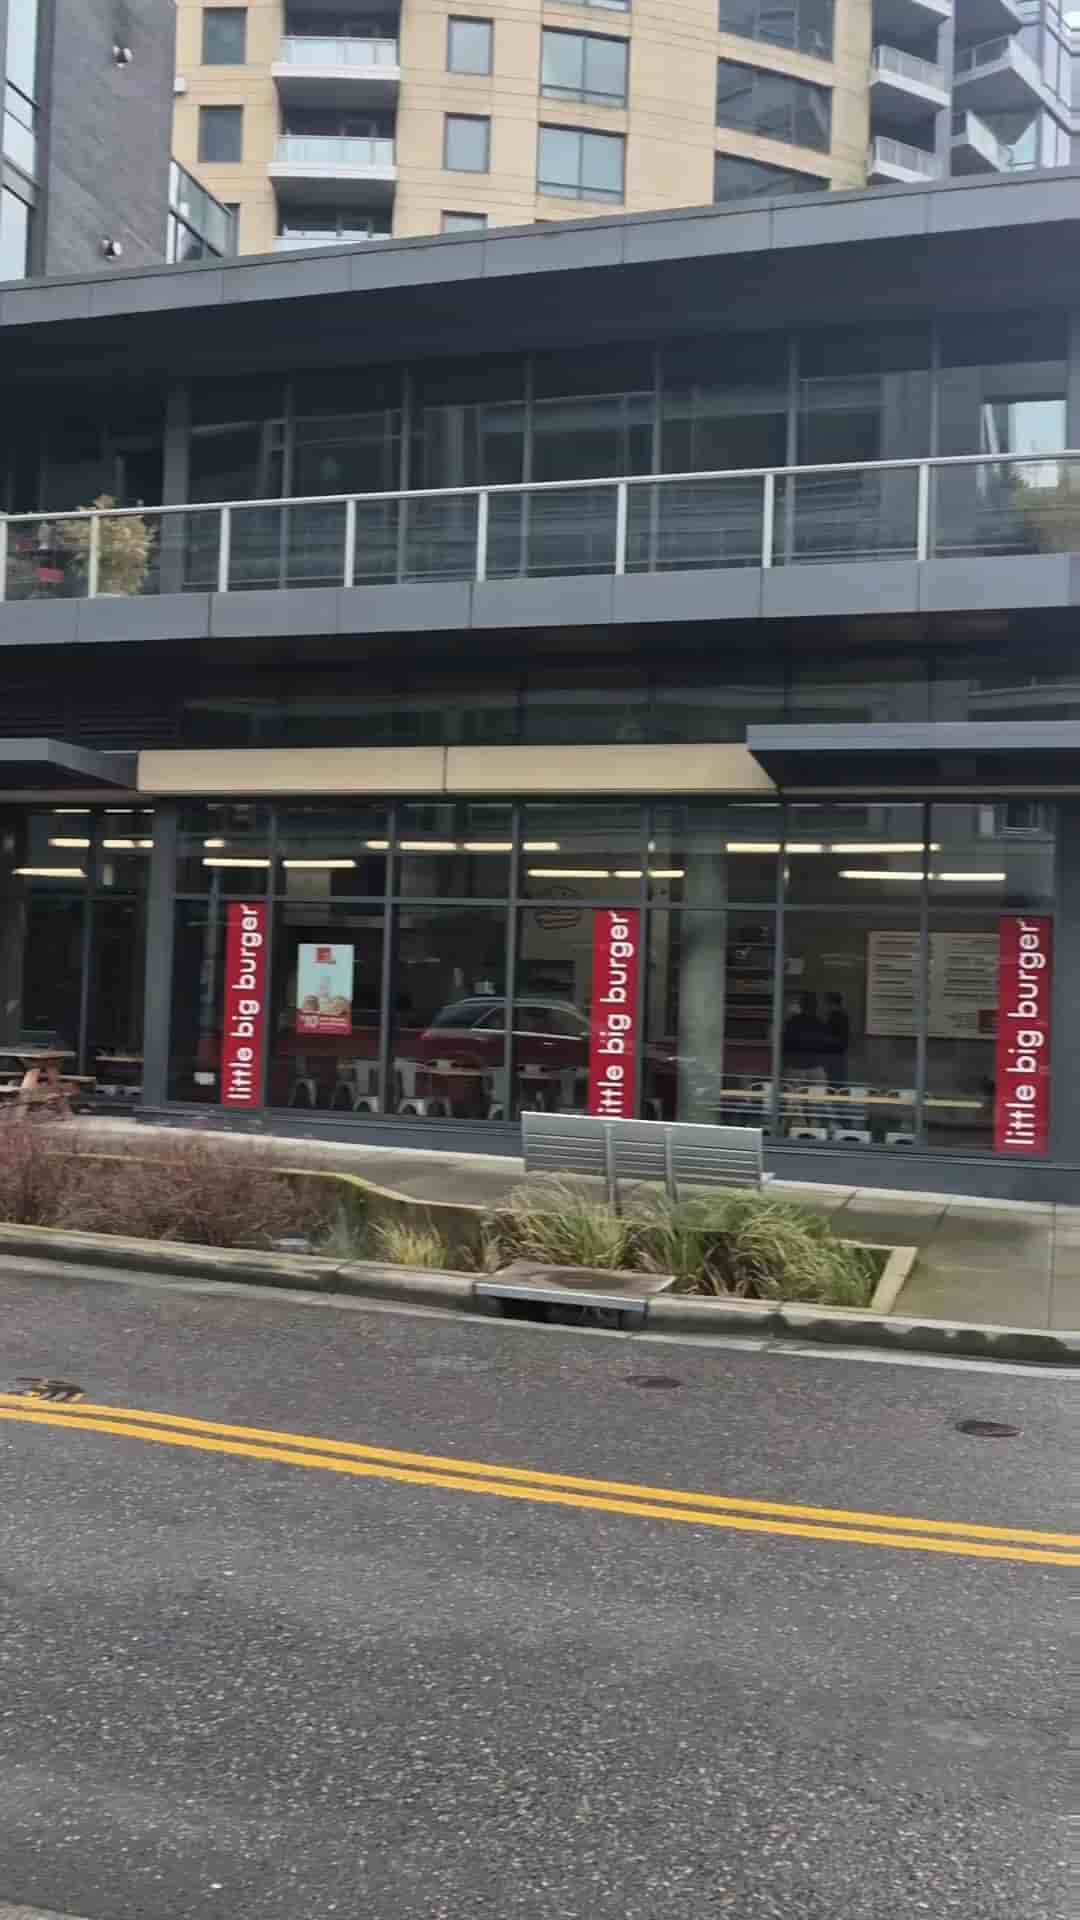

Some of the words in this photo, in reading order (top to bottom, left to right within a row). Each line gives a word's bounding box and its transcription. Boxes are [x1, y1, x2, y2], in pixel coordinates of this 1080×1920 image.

[230, 904, 264, 990] burger
[599, 911, 635, 1003] burger
[1007, 919, 1046, 1018] burger
[230, 999, 262, 1038] big
[598, 1013, 633, 1055] big
[228, 1047, 254, 1101] little
[1005, 1030, 1046, 1073] big
[1005, 1084, 1037, 1145] little
